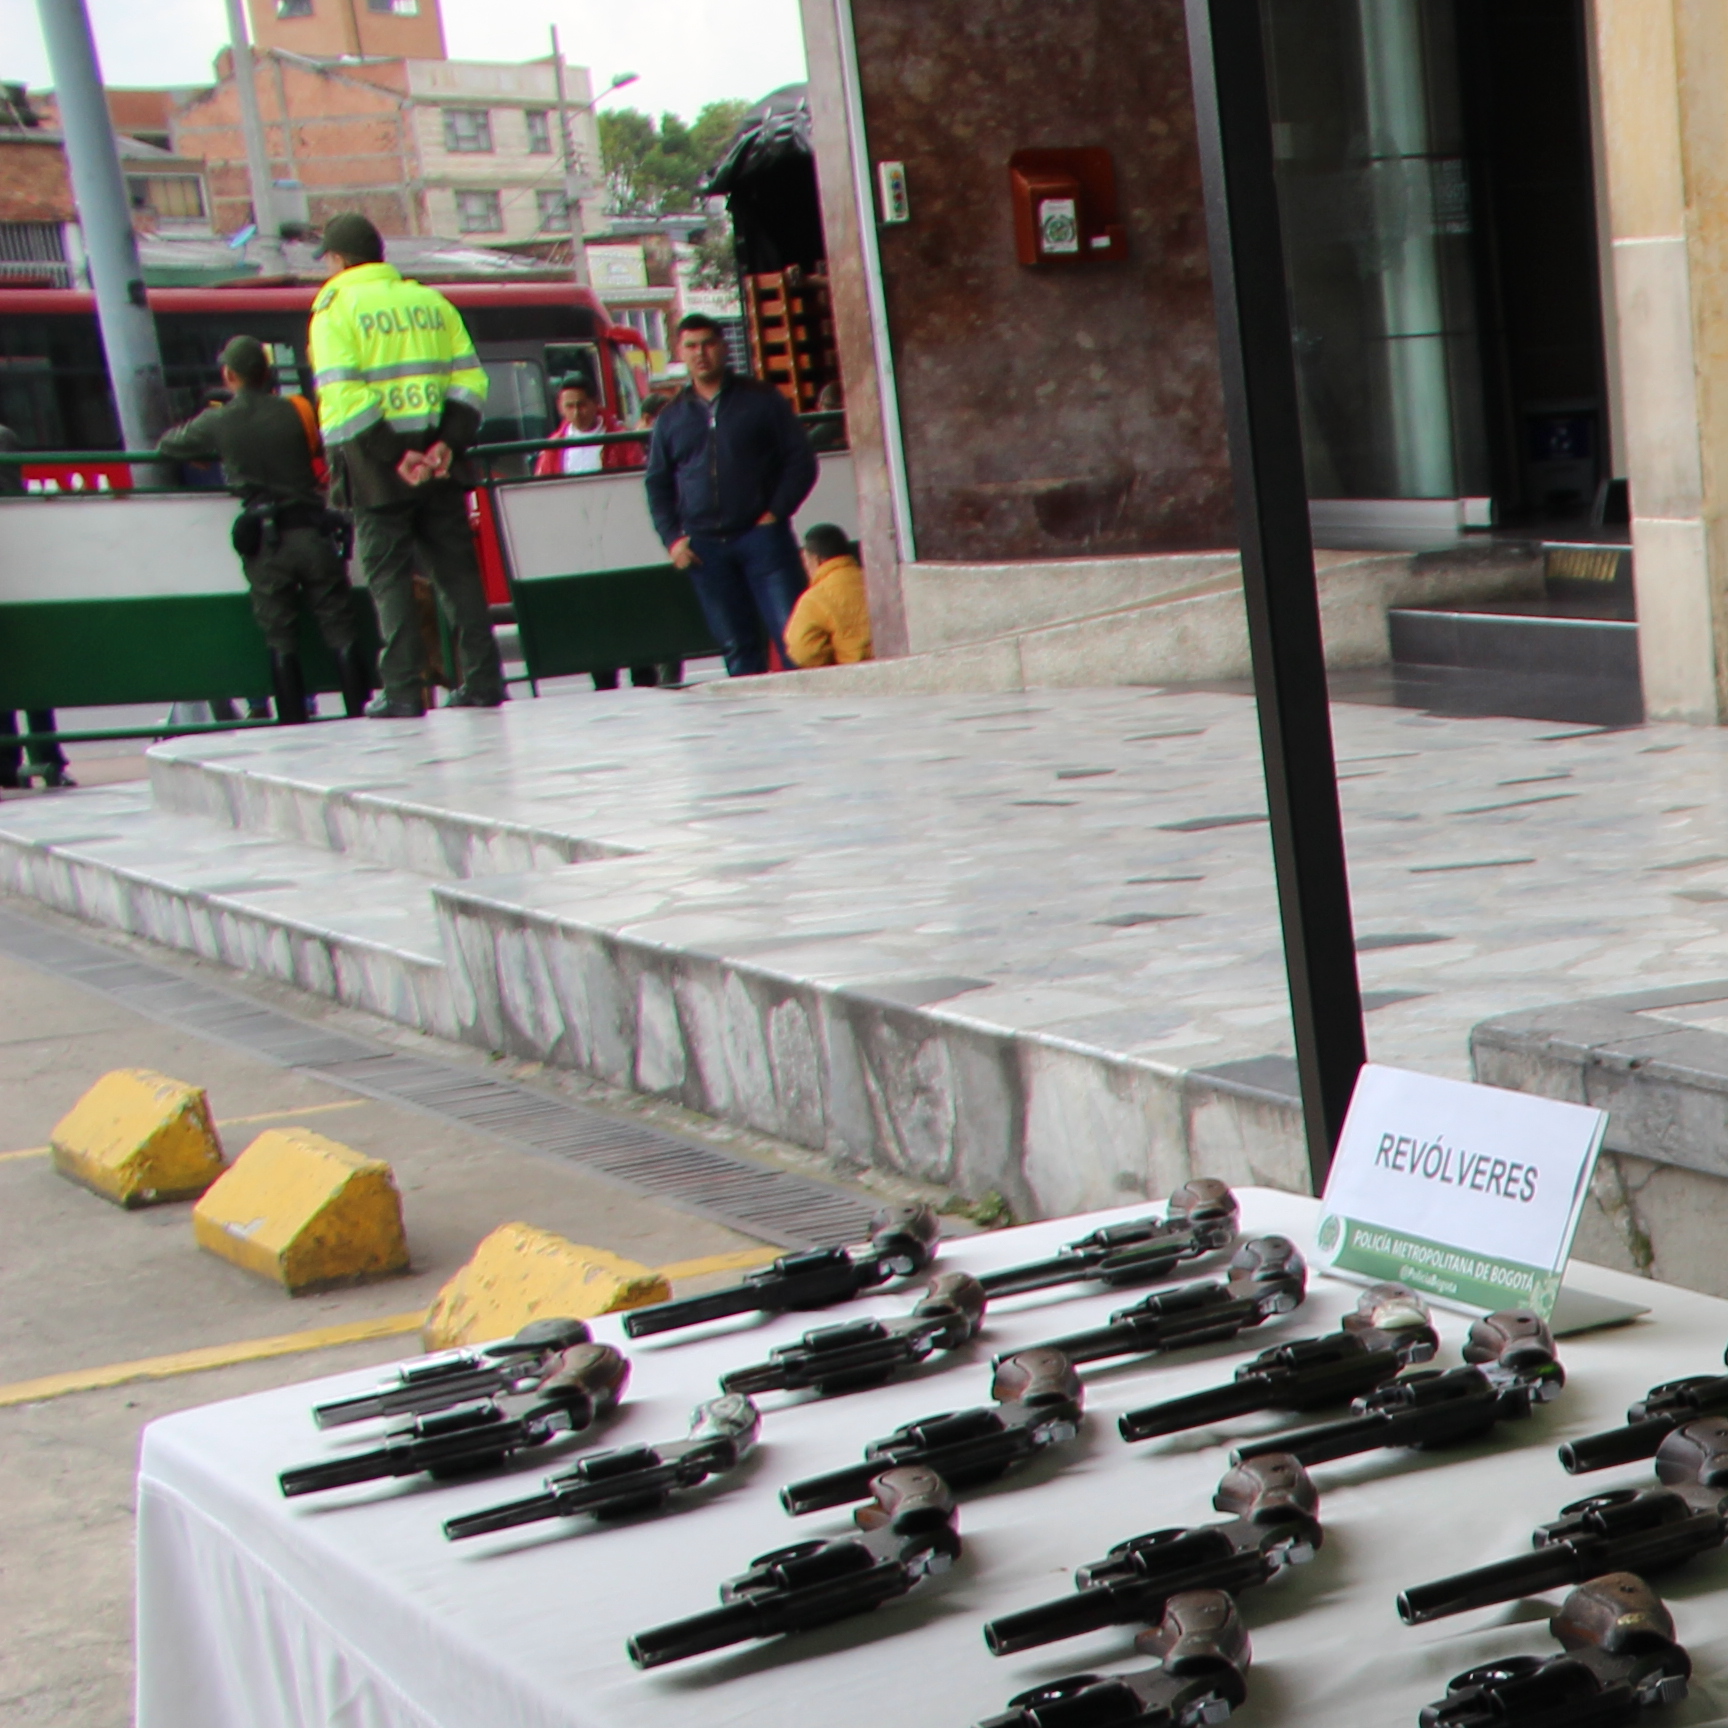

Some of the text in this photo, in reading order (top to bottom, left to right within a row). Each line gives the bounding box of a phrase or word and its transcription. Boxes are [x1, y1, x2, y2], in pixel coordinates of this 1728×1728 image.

[360, 307, 446, 338] POLICIA
[1374, 1132, 1539, 1203] REVÓLVERES
[1353, 1230, 1535, 1292] POLICÍA METROPOLITANA DE BOGOTÁ
